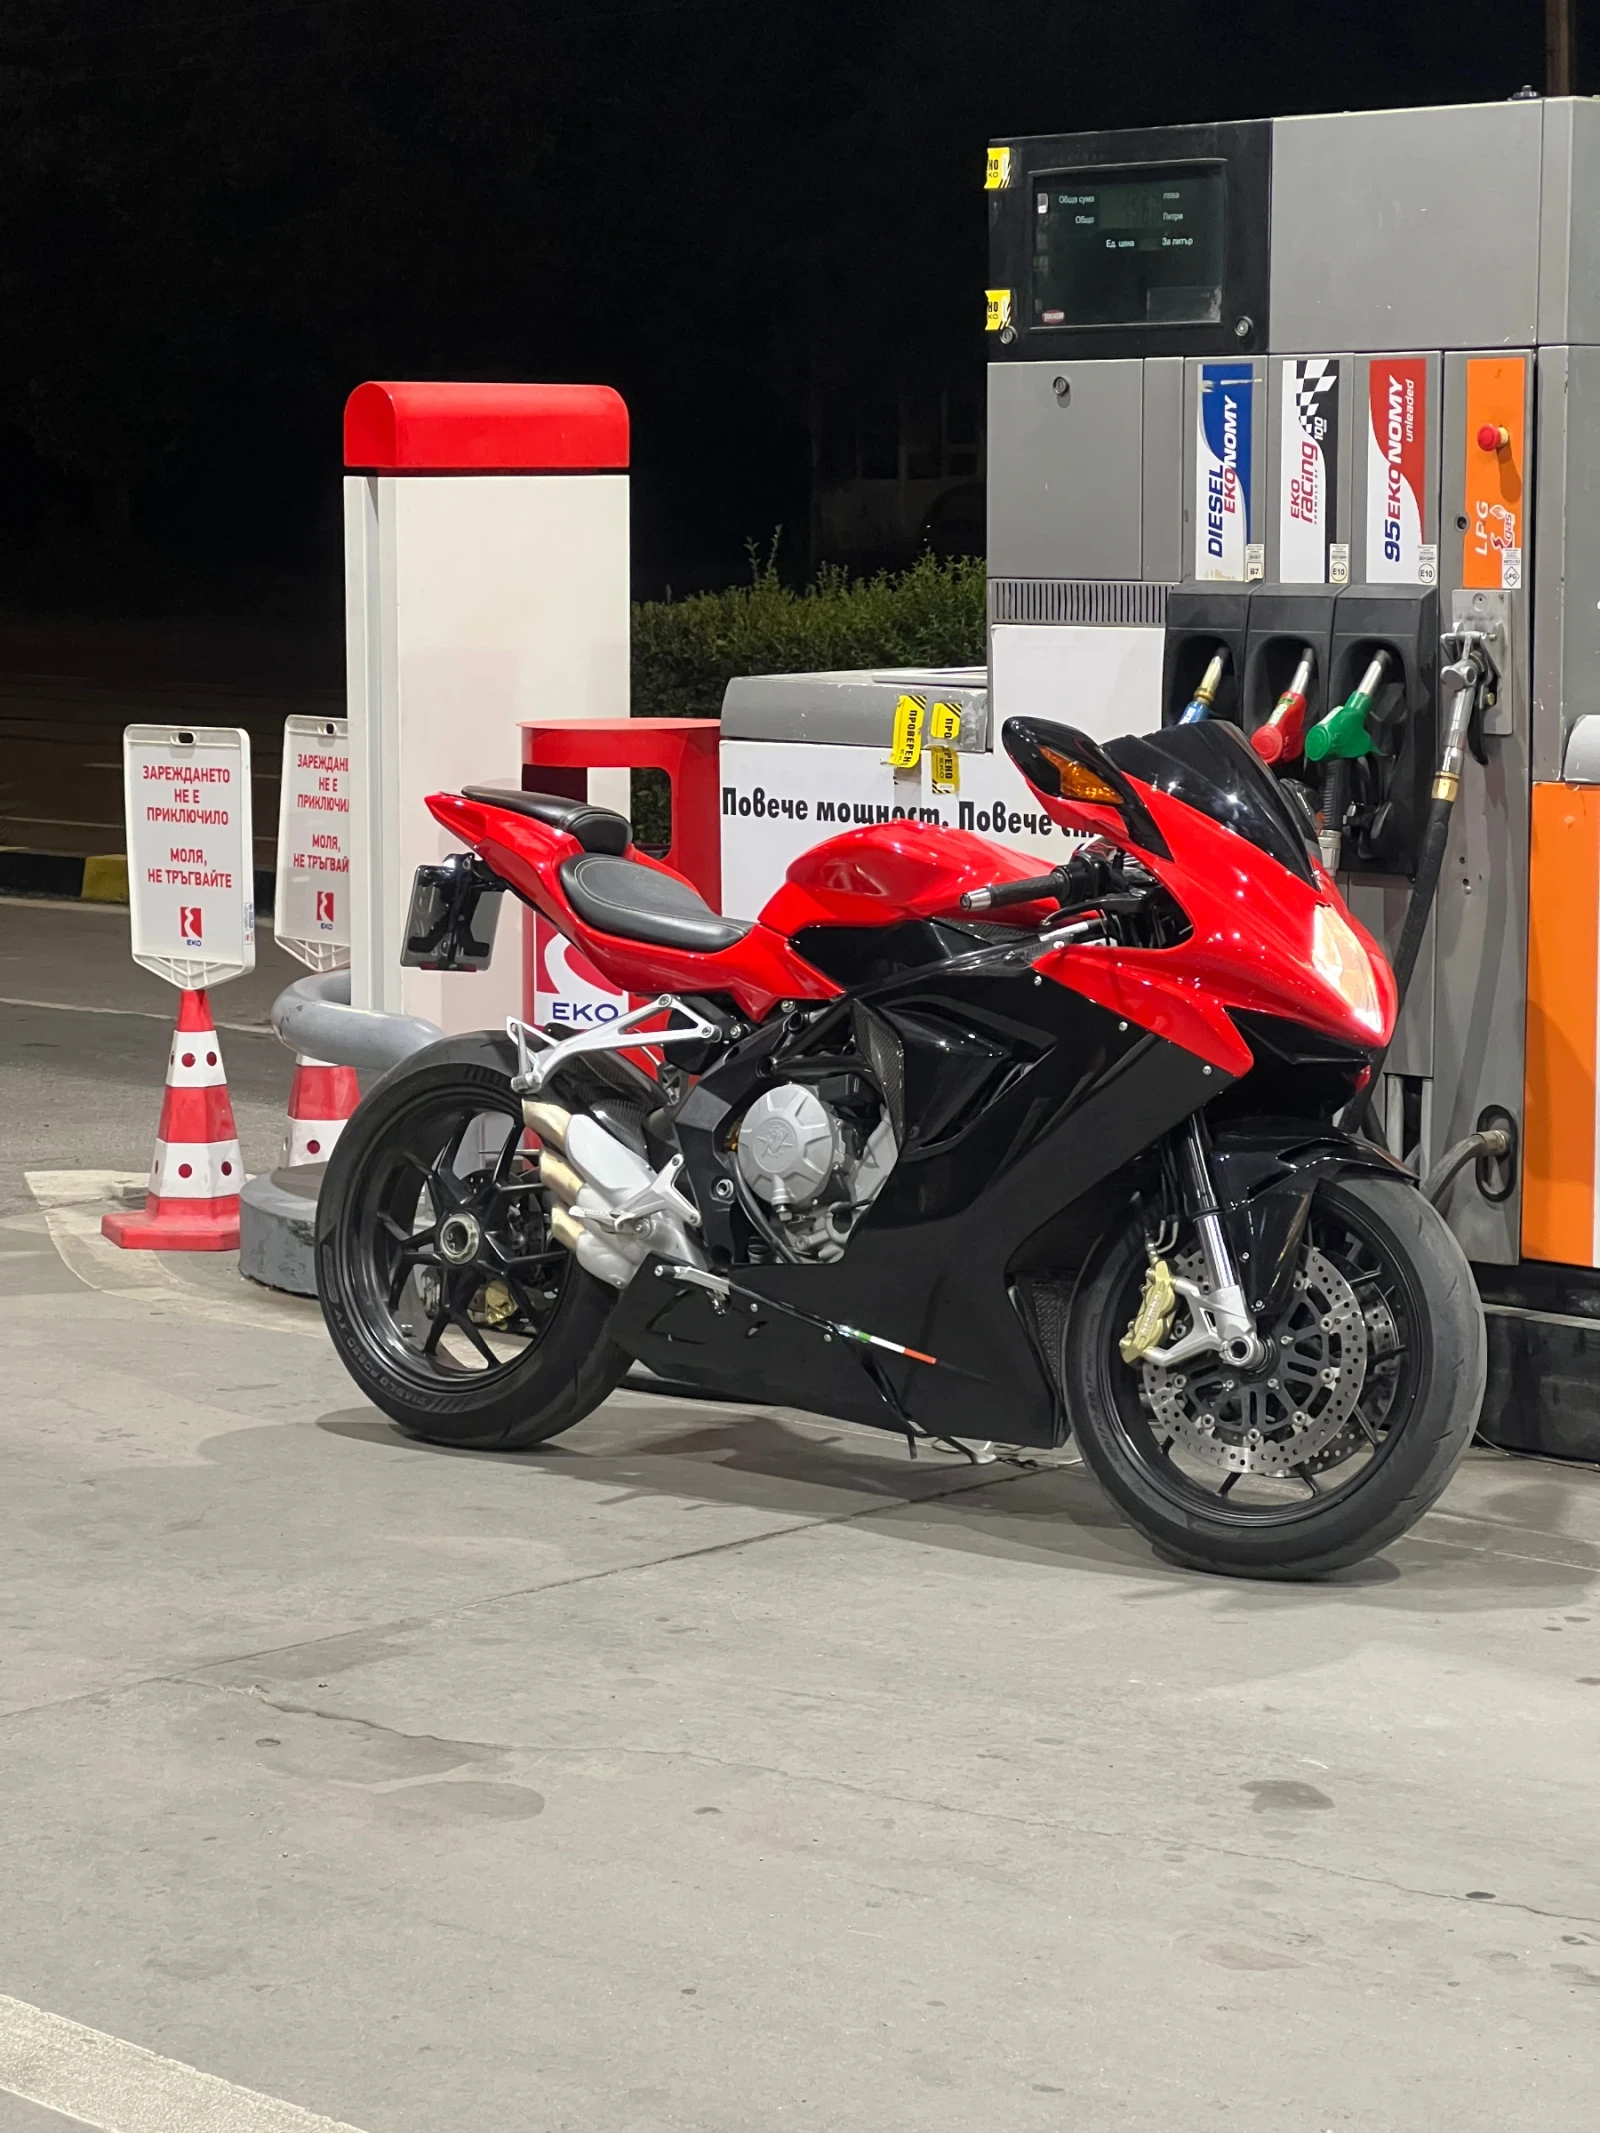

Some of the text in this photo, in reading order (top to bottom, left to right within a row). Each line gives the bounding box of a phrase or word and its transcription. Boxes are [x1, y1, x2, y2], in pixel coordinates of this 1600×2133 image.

[1405, 378, 1415, 443] unleaded
[1314, 416, 1324, 441] 100
[1300, 440, 1318, 524] racing
[1290, 478, 1300, 519] EKO
[1208, 464, 1224, 558] DIESEL
[1475, 500, 1489, 556] LPG
[1332, 568, 1345, 576] E10
[1420, 569, 1433, 578] E10
[902, 709, 918, 765] ПРОВЕРЕН
[142, 765, 231, 784] ЗАРЕЖДАНЕТО
[318, 777, 338, 793] НЕ Е
[174, 789, 201, 804] НЕ Е
[146, 807, 229, 826] ПРИКЛЮЧИЛО
[722, 786, 809, 822] Повече
[958, 800, 1053, 836] Повече
[312, 834, 341, 853] МОЛЯ,
[170, 848, 208, 867] МОЛЯ,
[293, 853, 305, 869] НЕ
[147, 868, 233, 889] НЕ ТРЪГВАЙТЕ
[320, 922, 334, 930] EKO
[186, 939, 202, 947] EKO
[552, 1002, 619, 1023] EKO
